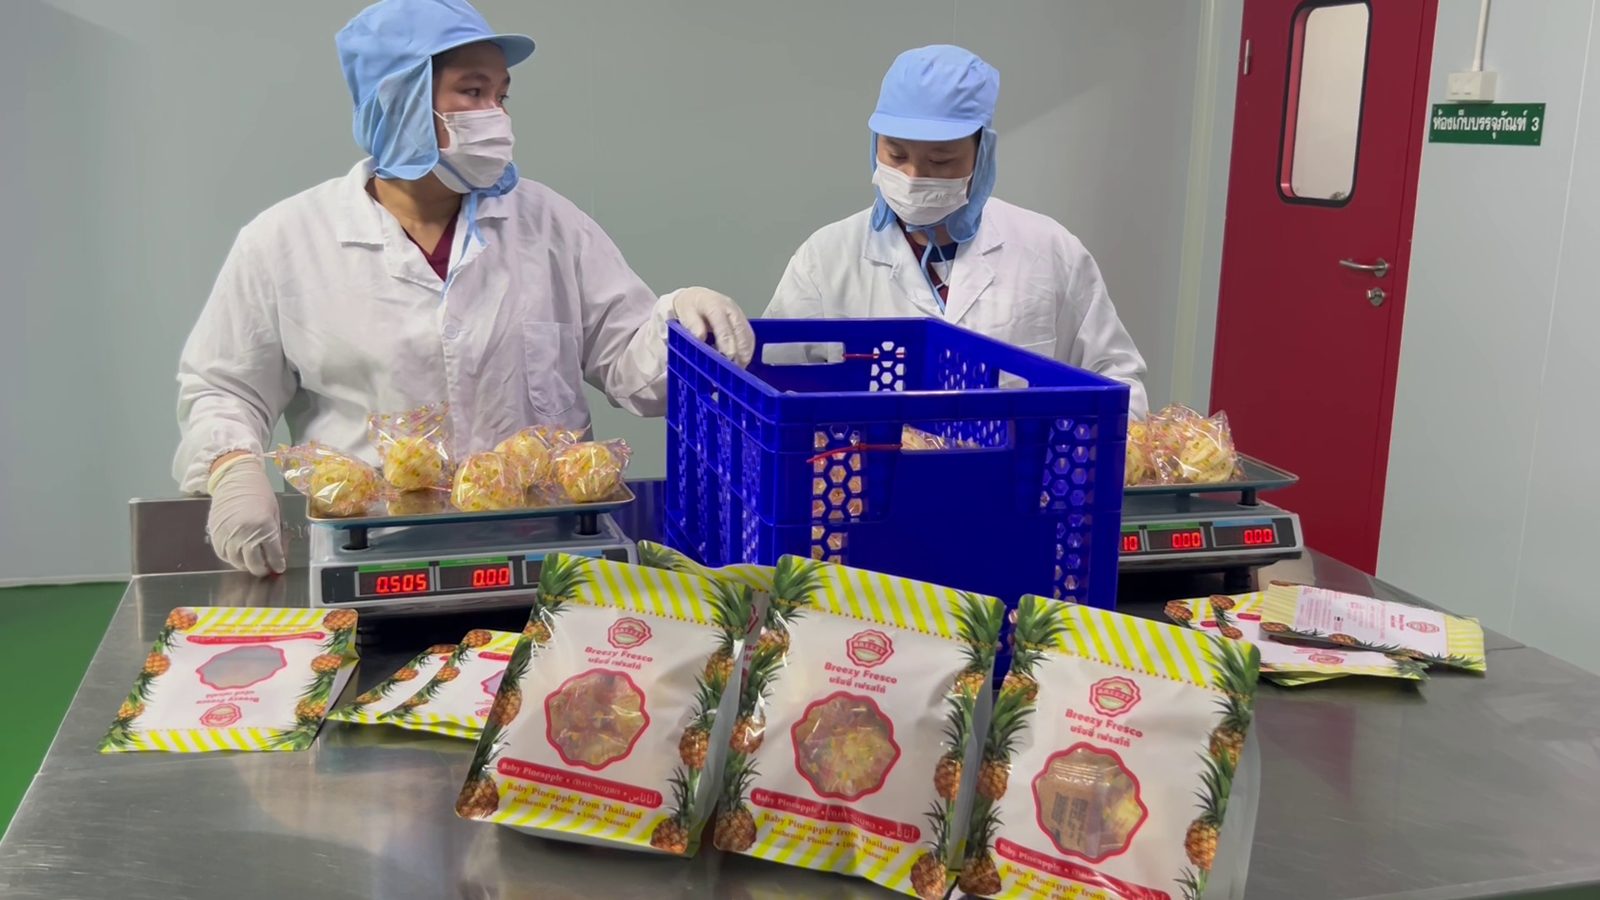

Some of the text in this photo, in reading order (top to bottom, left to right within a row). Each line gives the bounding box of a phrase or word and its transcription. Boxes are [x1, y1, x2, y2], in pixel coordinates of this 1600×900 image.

[1432, 109, 1540, 139] ห้องเก็บบรรจุภัณฑ์ 3
[1172, 532, 1201, 548] 0.00
[1244, 529, 1273, 544] 0.00
[376, 574, 427, 593] 0.505
[473, 568, 510, 586] 0.00
[585, 646, 653, 662] Breezy Fresco
[824, 662, 897, 684] Breezy Fresco
[1065, 708, 1143, 738] Breezy Fresco
[501, 762, 563, 782] Baby Pineapple
[507, 782, 528, 795] Baby
[531, 787, 577, 804] Pineapple
[578, 798, 600, 809] from
[603, 804, 642, 819] Thailand
[756, 792, 817, 813] Baby Pineapple
[764, 813, 784, 825] Baby
[788, 819, 833, 834] Pineapple
[836, 829, 858, 839] from
[861, 835, 900, 853] Thailand
[1018, 852, 1060, 872] Pineapple
[1006, 865, 1026, 878] Baby
[1030, 873, 1078, 894] Pineapple
